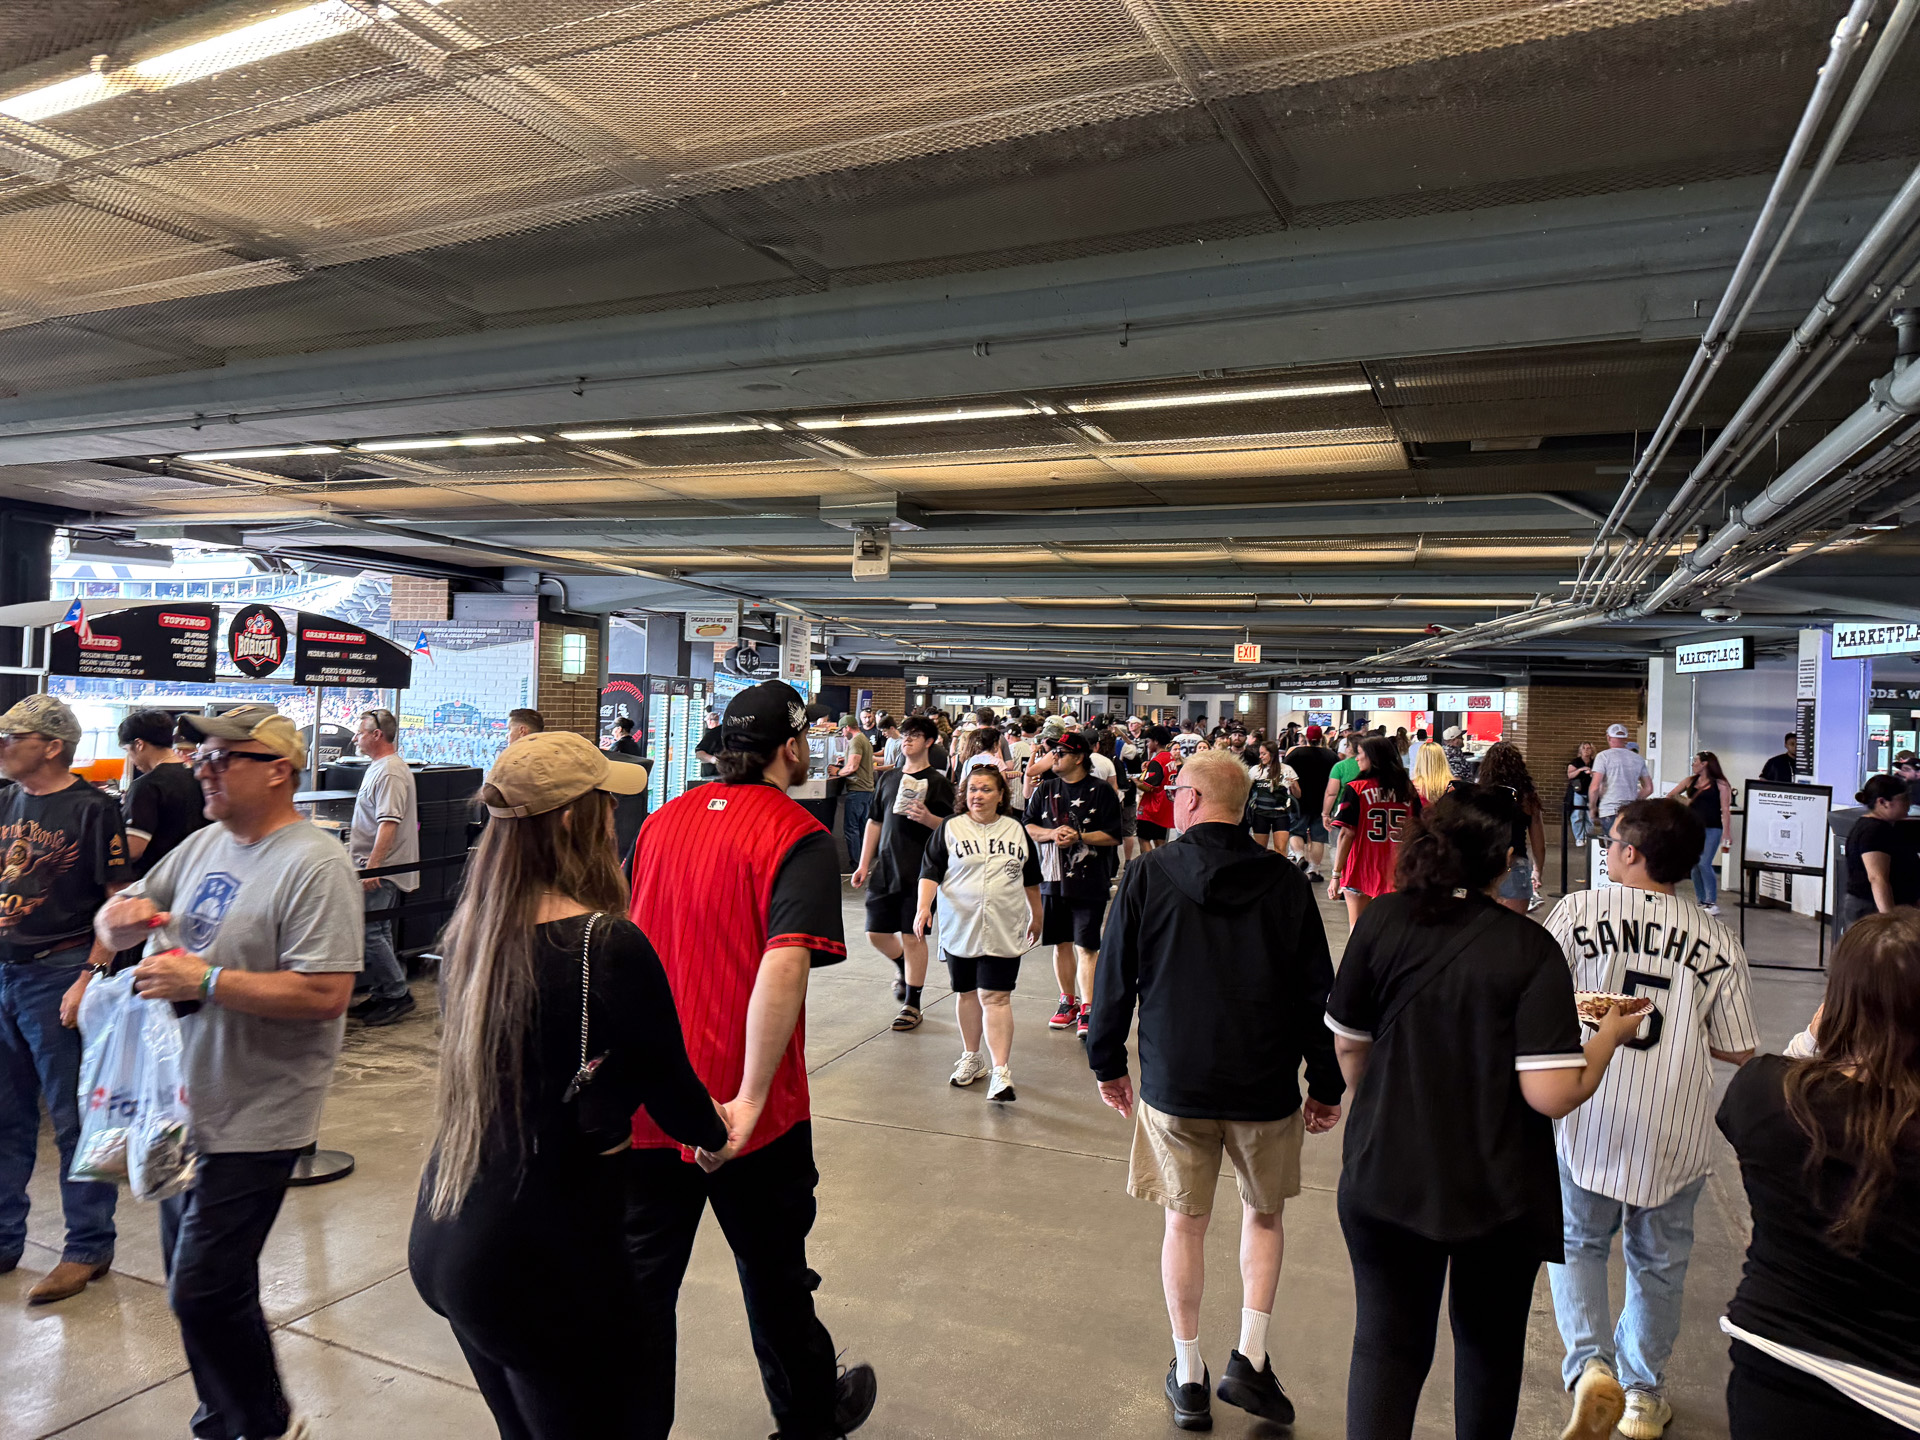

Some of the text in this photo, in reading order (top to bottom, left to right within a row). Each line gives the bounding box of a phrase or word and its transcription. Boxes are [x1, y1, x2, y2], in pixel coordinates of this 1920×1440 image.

[163, 615, 206, 627] TOPPINGS
[237, 635, 278, 660] BORICUA
[305, 631, 365, 642] GRAND SLAM BOWL
[1237, 645, 1257, 658] EXIT
[1678, 647, 1740, 666] MARKETPLACE
[1784, 794, 1816, 802] RECEIPT?
[25, 819, 65, 849] People
[1367, 808, 1407, 843] 35
[955, 838, 1025, 861] CHICAGO
[1573, 909, 1731, 987] SÁNCHEZ
[1612, 969, 1672, 1051] 5
